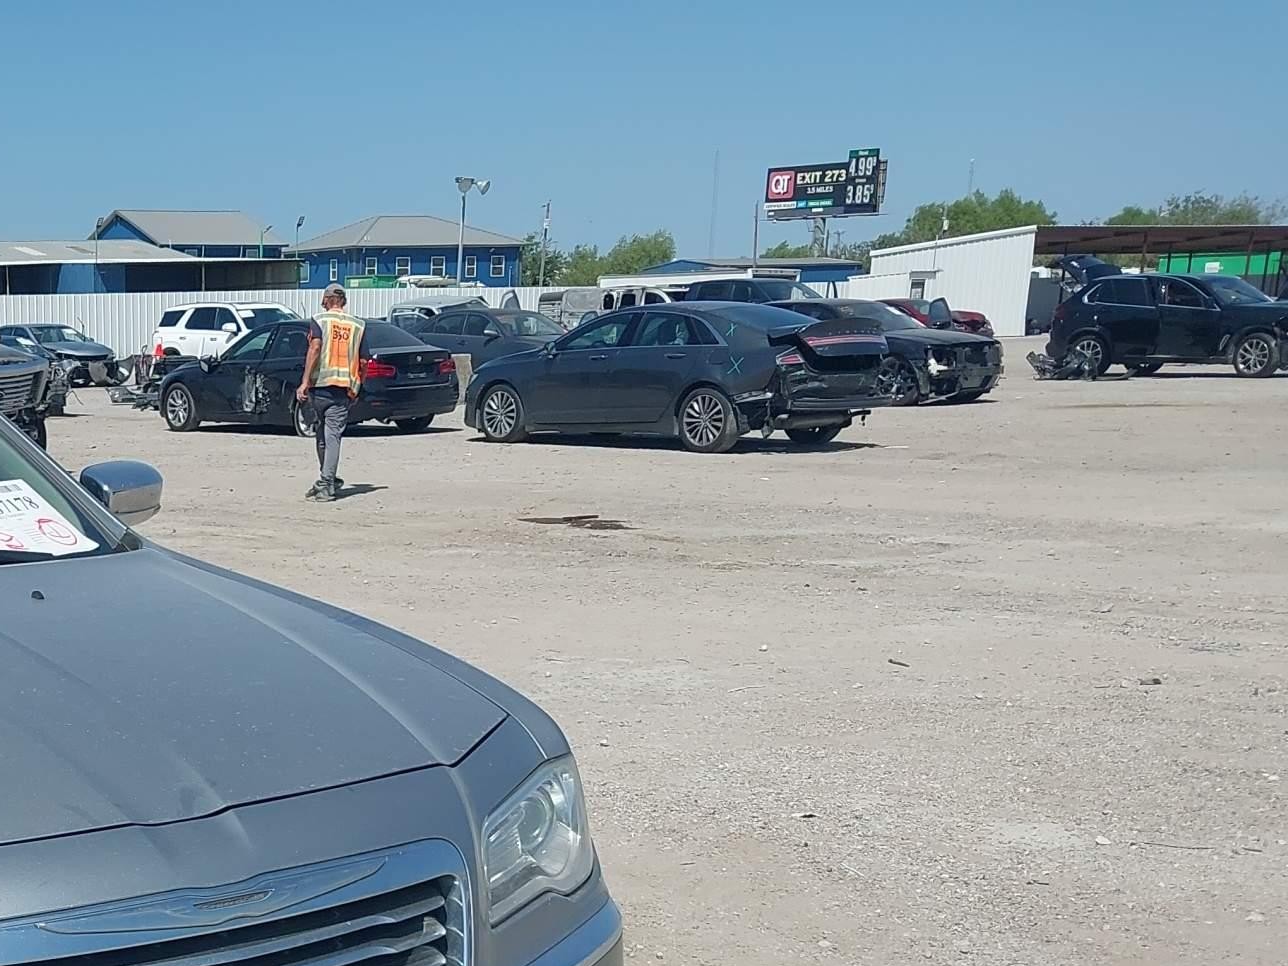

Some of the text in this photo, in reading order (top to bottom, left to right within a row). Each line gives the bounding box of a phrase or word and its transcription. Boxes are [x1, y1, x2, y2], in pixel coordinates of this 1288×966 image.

[771, 175, 790, 195] QT
[797, 173, 823, 184] EXIT
[824, 170, 846, 182] 273
